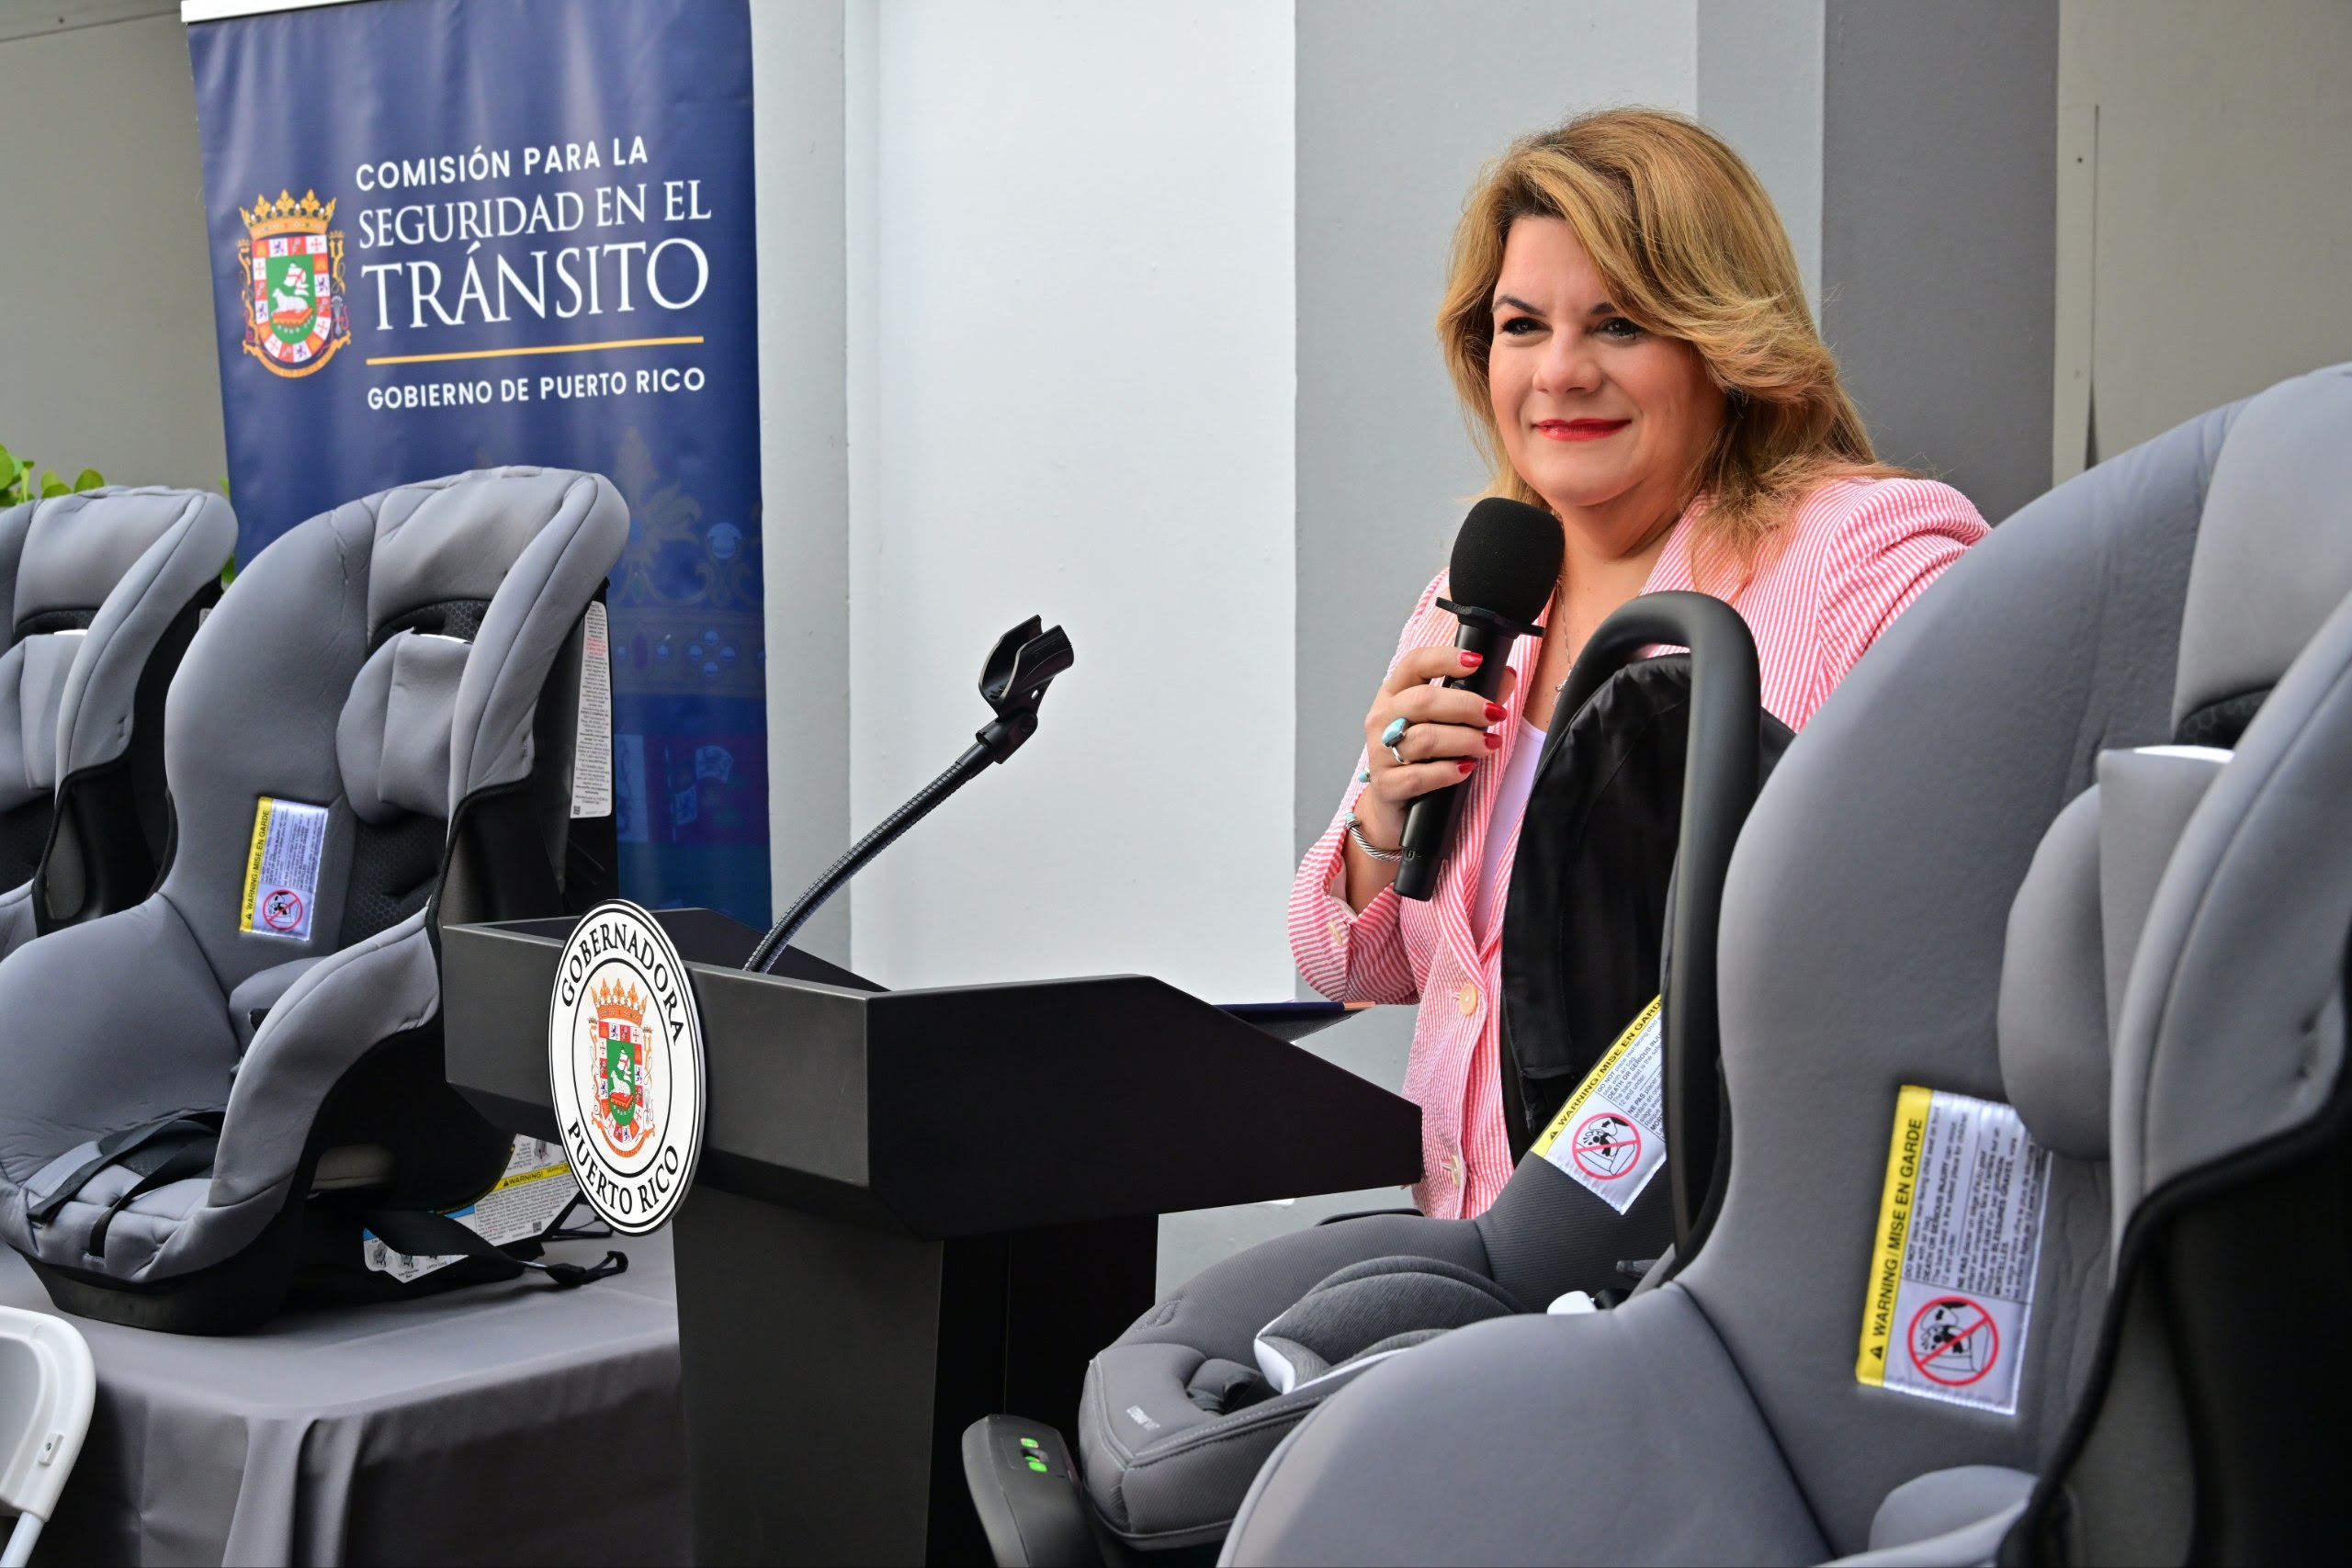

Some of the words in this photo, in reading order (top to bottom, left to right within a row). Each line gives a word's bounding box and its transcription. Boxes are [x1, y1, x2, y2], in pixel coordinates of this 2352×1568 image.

[356, 144, 511, 191] COMISIÓN
[524, 141, 602, 175] PARA
[613, 135, 648, 166] LA
[358, 190, 584, 249] SEGURIDAD
[594, 184, 647, 228] EN
[663, 180, 712, 221] EL
[361, 238, 709, 331] TRÁNSITO
[368, 380, 492, 411] GOBIERNO
[501, 378, 529, 402] DE
[540, 371, 628, 400] PUERTO
[636, 367, 705, 393] RICO
[256, 839, 264, 850] EN
[258, 809, 269, 838] GARDE
[253, 852, 261, 870] MISE
[246, 874, 257, 909] WARNING
[561, 921, 684, 1046] GOBERNADORA
[1555, 1076, 1600, 1127] WARNING
[1598, 1047, 1623, 1074] MISE
[1620, 1031, 1635, 1047] EN
[1596, 1082, 1606, 1092] DO
[1603, 1070, 1615, 1083] NOT
[1613, 1057, 1627, 1072] place
[1645, 1019, 1657, 1032] child
[1606, 1079, 1624, 1100] DEATH
[1621, 1070, 1632, 1080] OR
[1628, 1045, 1651, 1071] SERIOUS
[1648, 1031, 1662, 1047] INJU
[1626, 1104, 1636, 1113] NE
[1634, 1092, 1645, 1105] PAS
[1642, 1077, 1658, 1094] placer
[568, 1117, 632, 1215] PUERTO
[637, 1145, 679, 1213] RICO
[1900, 1117, 1922, 1179] GARDE
[1894, 1181, 1911, 1205] EN
[1887, 1210, 1905, 1250] MISE
[1872, 1258, 1897, 1337] WARNING
